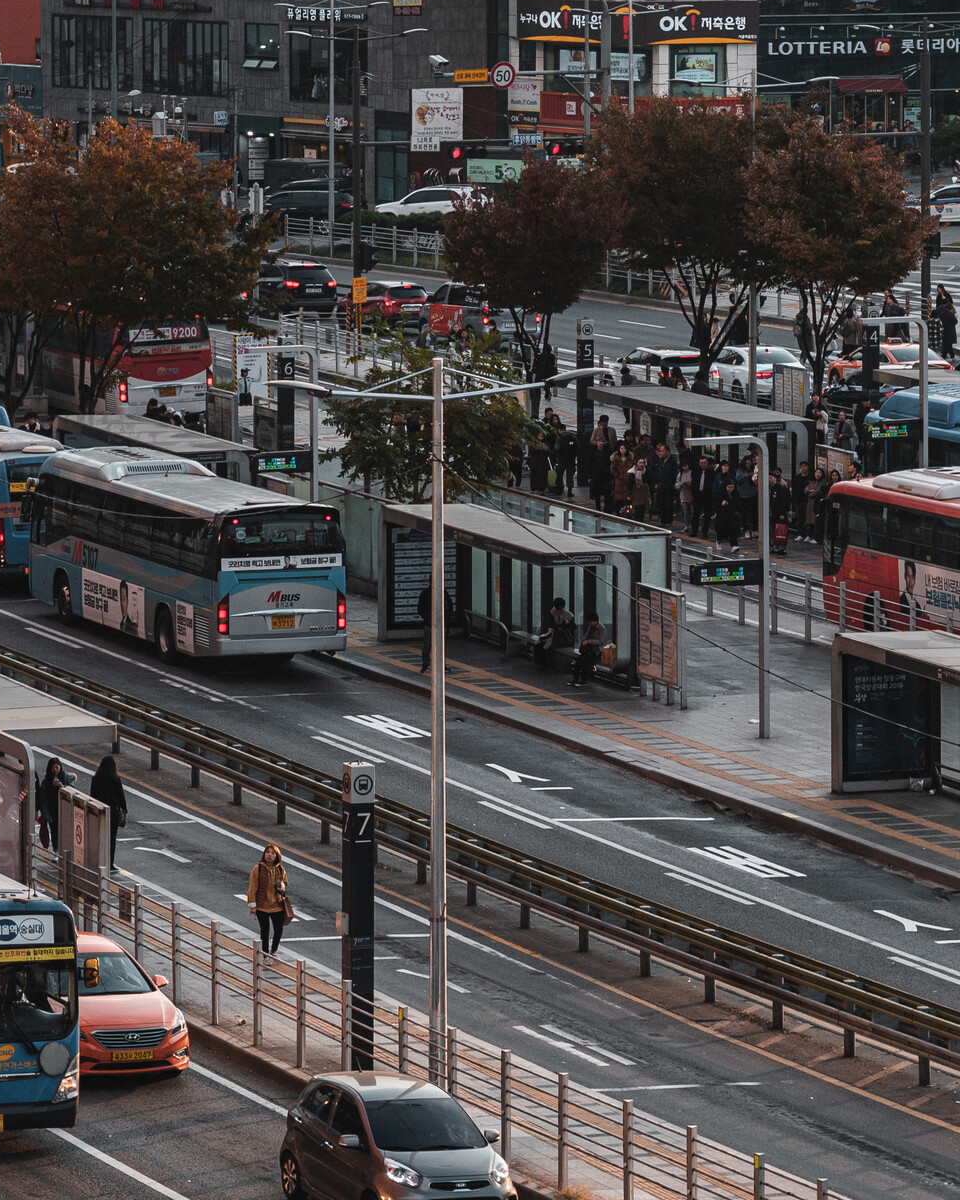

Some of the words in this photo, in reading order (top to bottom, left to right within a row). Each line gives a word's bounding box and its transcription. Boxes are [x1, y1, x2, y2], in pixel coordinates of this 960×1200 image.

[701, 17, 746, 30] 저축은행
[768, 41, 867, 55] LOTTERIA
[496, 70, 511, 82] 50
[173, 326, 197, 338] 9200
[870, 330, 878, 342] 4
[584, 344, 592, 357] 5
[284, 362, 293, 375] 6
[932, 575, 944, 590] 보험
[357, 813, 371, 836] 7
[20, 923, 43, 935] 숭실대
[133, 1051, 152, 1060] 2047
